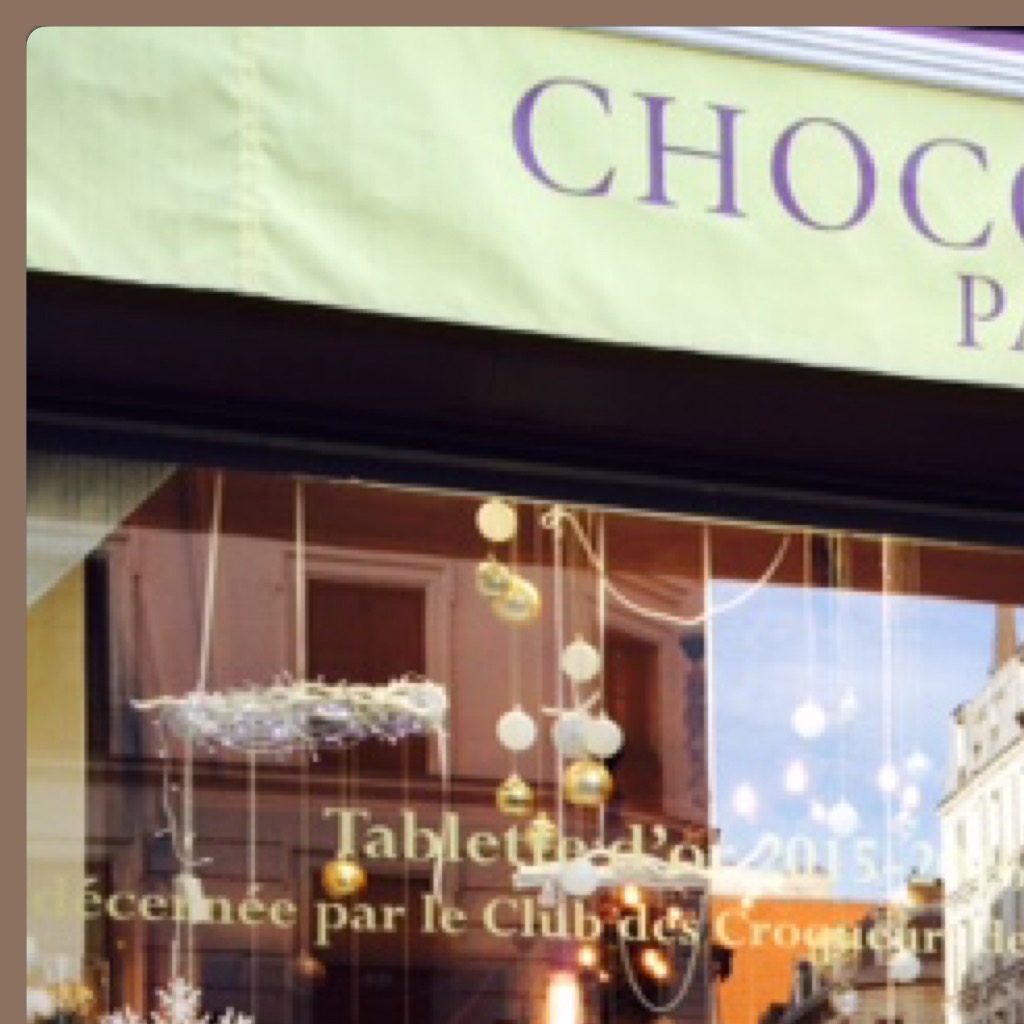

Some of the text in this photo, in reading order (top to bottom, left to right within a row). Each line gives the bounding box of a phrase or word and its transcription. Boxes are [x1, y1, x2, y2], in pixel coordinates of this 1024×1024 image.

[315, 902, 405, 946] par
[421, 894, 467, 934] le
[482, 895, 602, 941] Club
